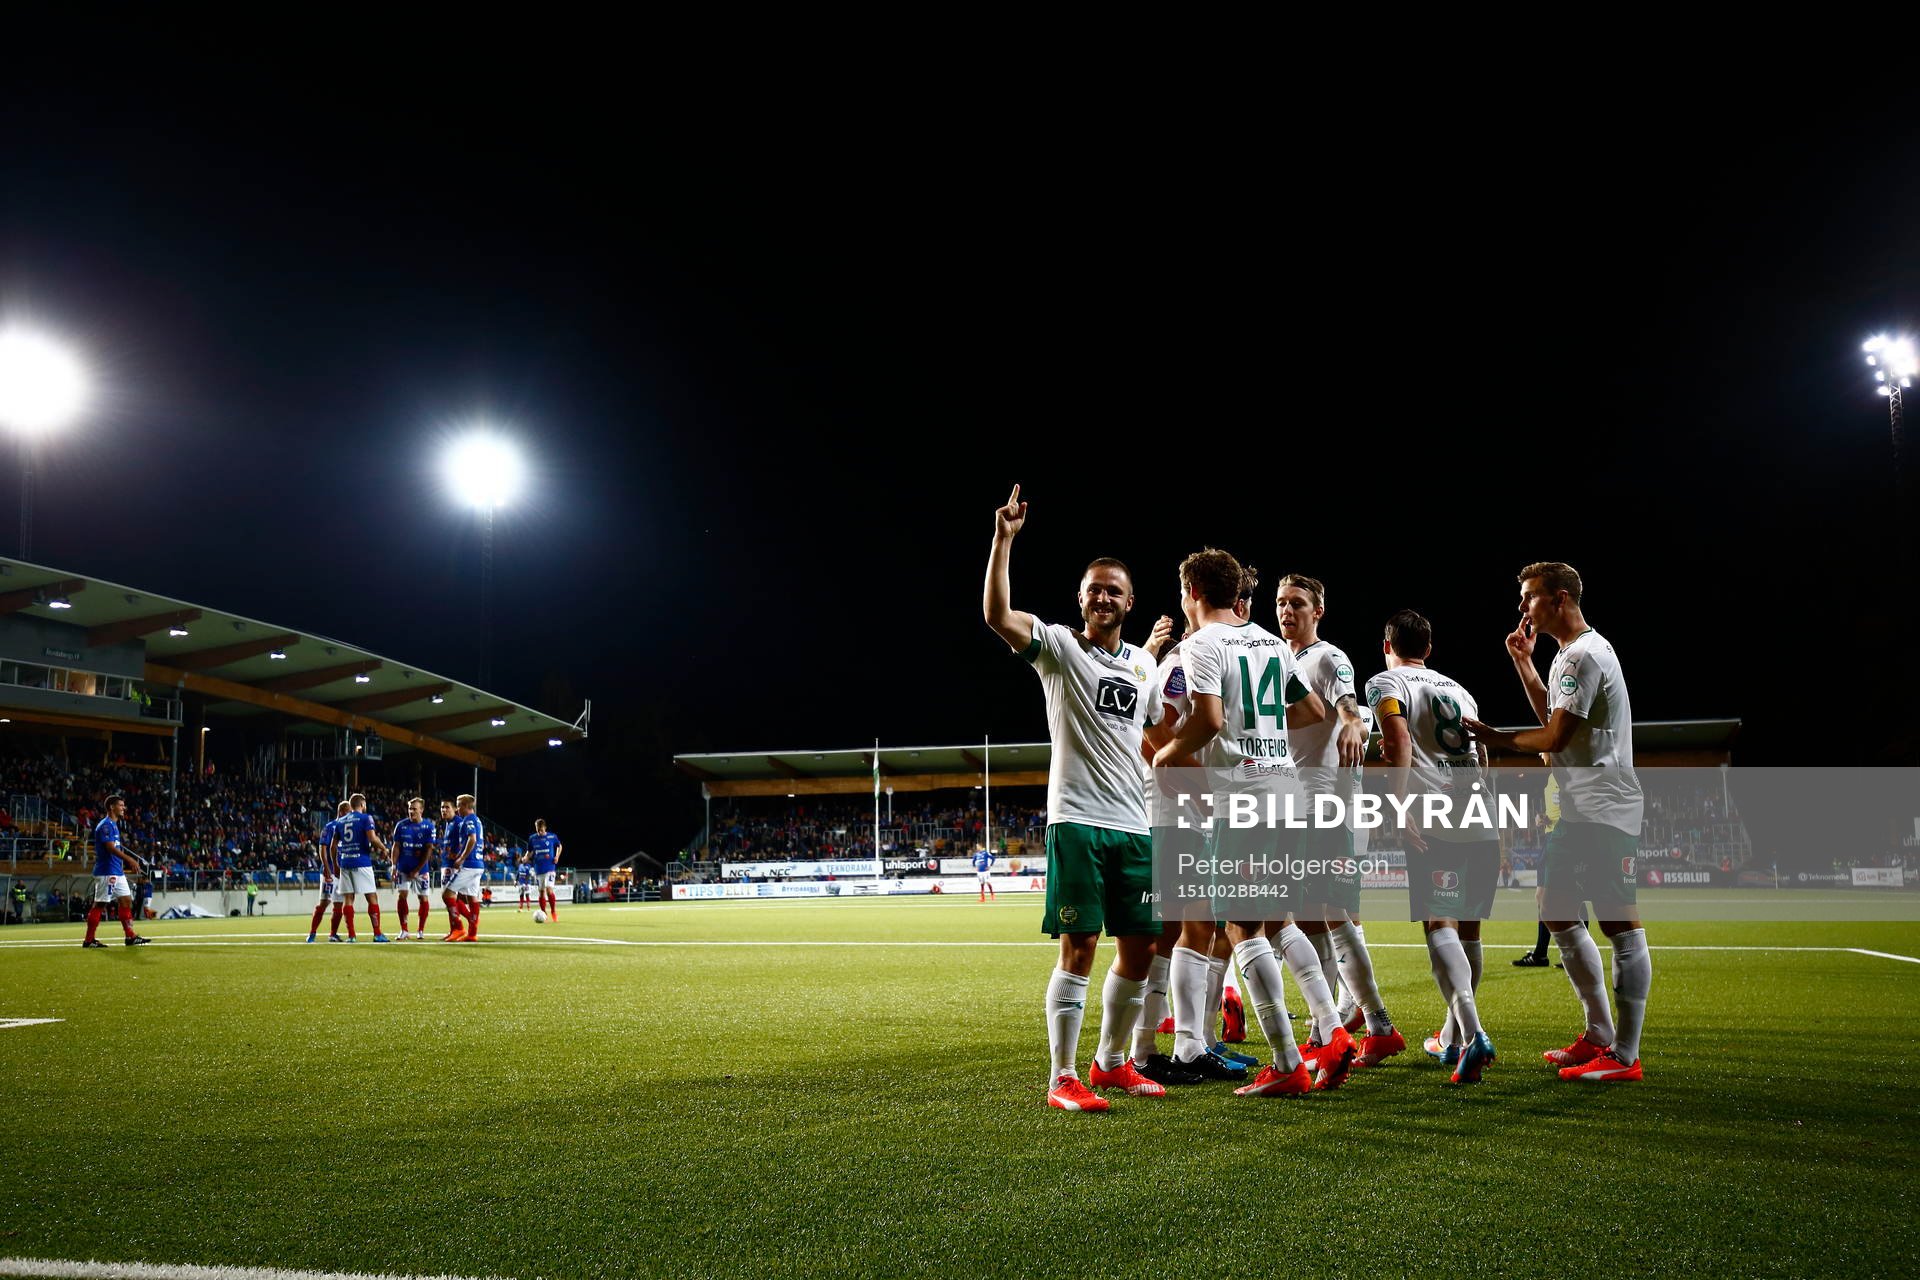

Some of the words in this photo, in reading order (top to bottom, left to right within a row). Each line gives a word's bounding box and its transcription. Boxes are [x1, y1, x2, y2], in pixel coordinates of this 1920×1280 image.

[1238, 656, 1284, 730] 14
[1432, 695, 1470, 756] 8
[344, 822, 354, 842] 5
[1636, 847, 1669, 859] lsport
[826, 864, 873, 873] TEKNORAMA
[885, 860, 927, 871] uhlsport
[769, 868, 791, 876] NCC
[1663, 872, 1711, 884] ASSALUB
[1808, 873, 1850, 881] Teknomedia
[688, 886, 714, 897] TIPS
[726, 885, 752, 896] ELIT
